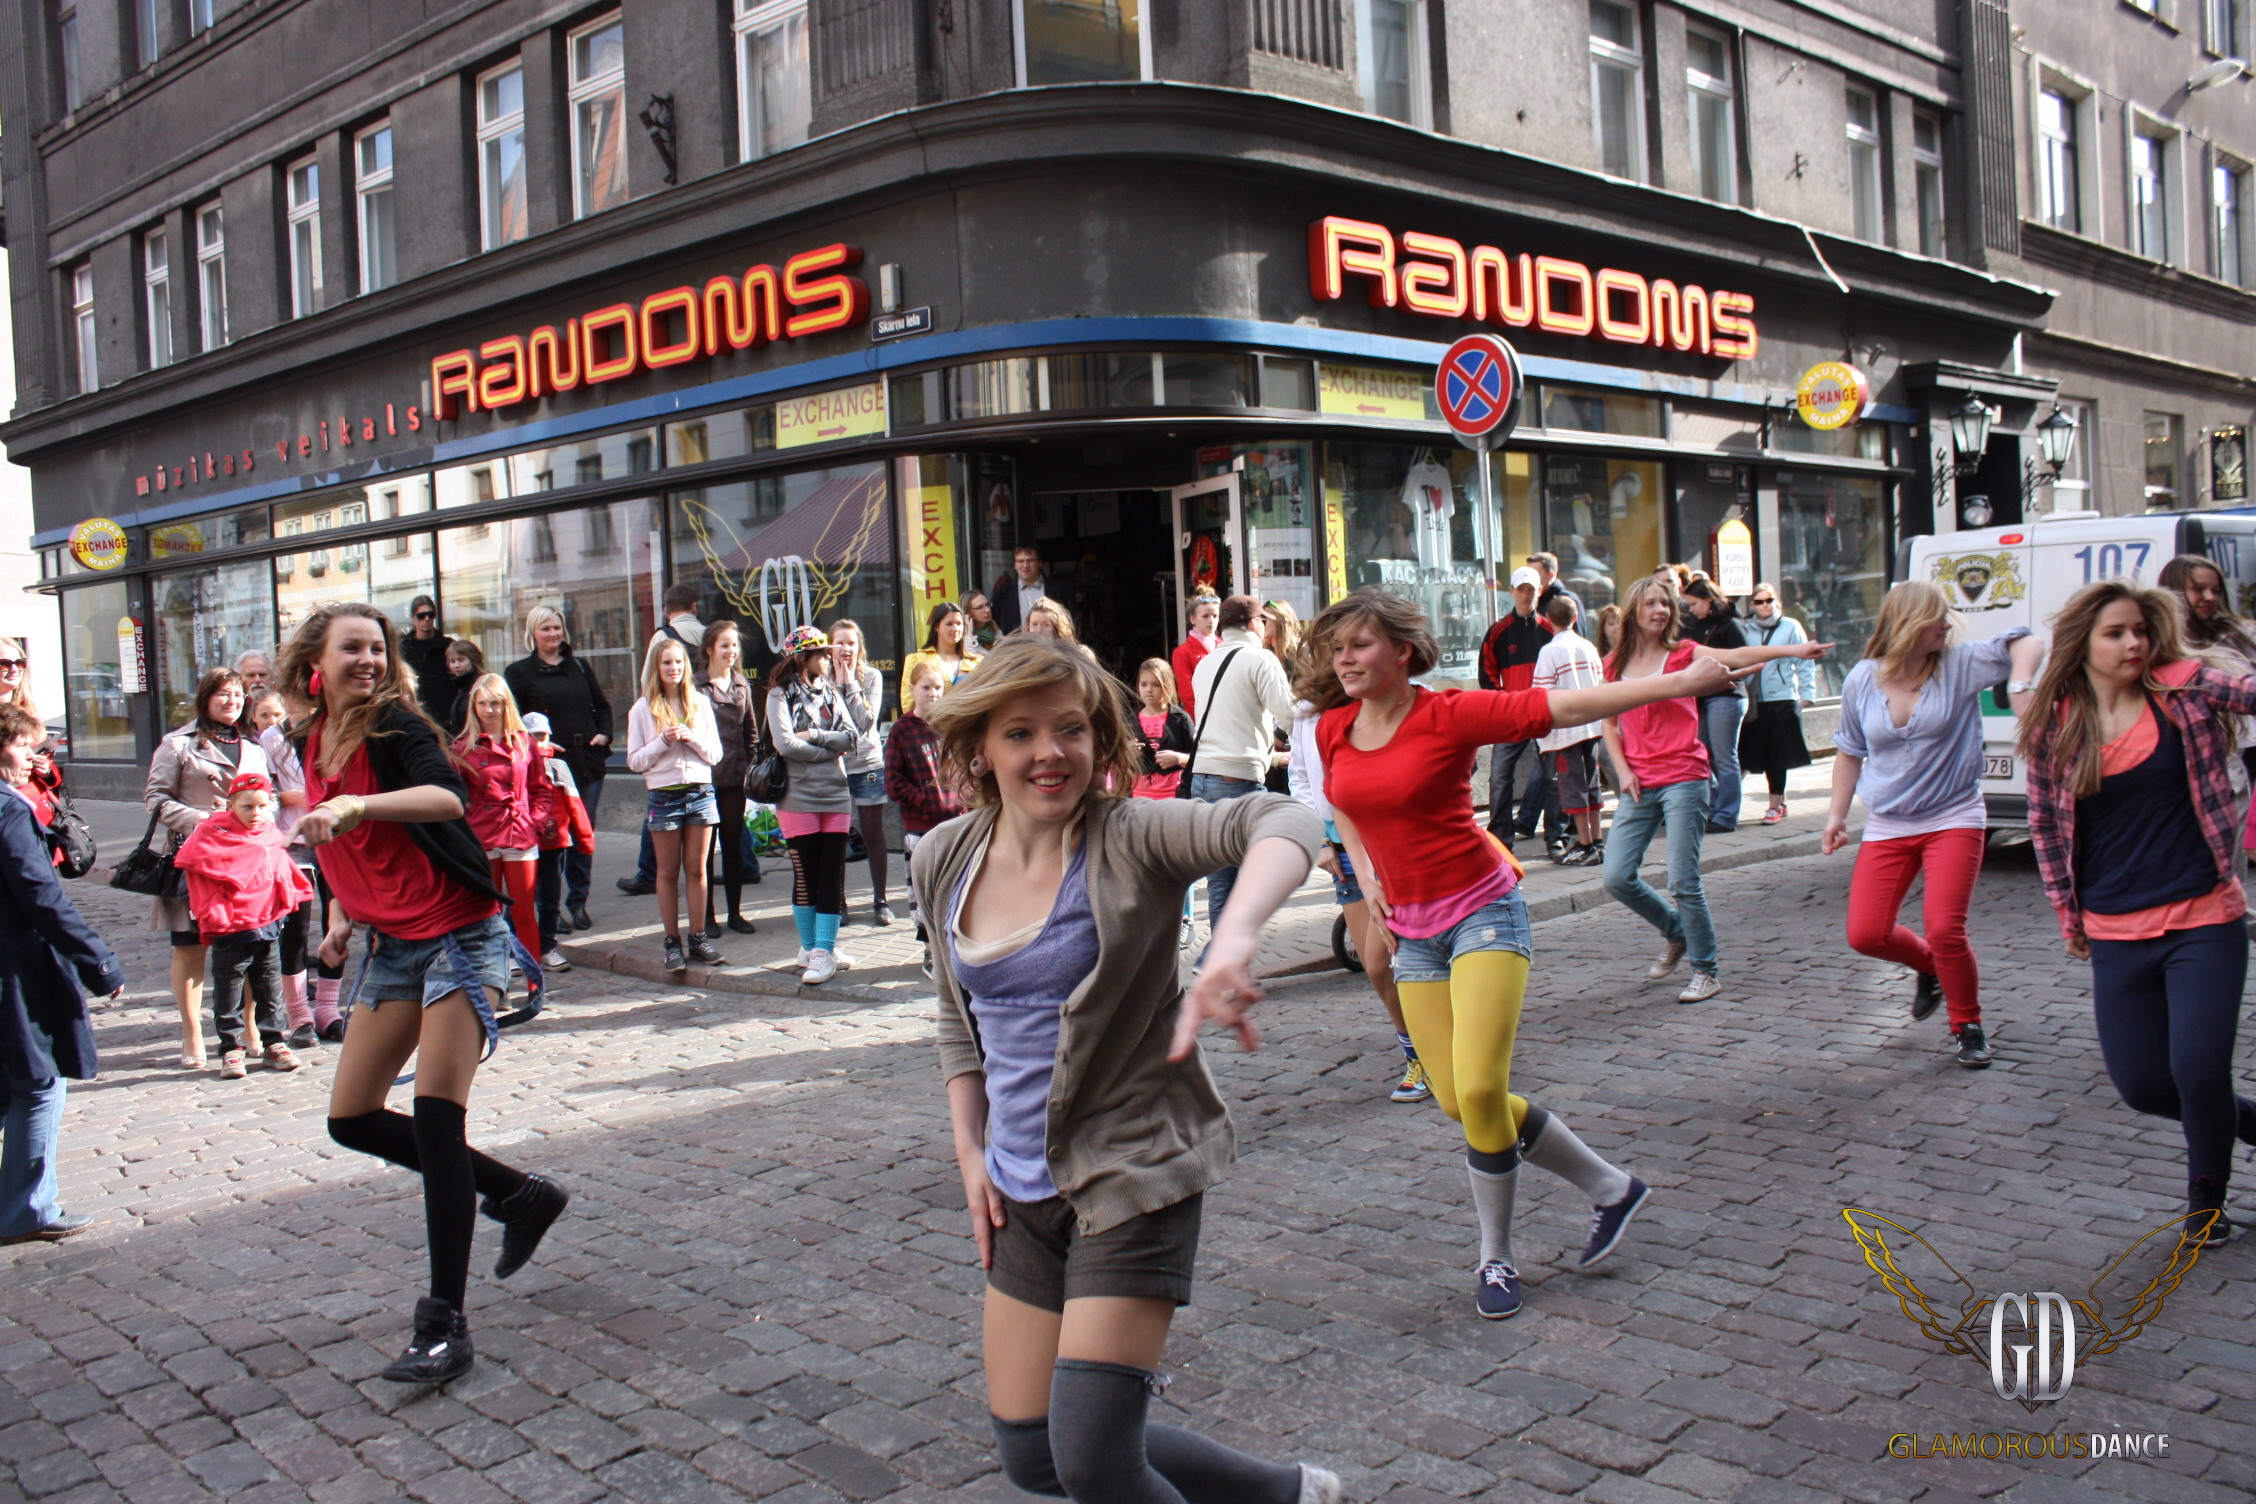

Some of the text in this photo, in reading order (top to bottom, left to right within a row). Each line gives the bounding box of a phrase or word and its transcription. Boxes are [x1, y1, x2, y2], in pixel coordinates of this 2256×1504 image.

[1319, 365, 1420, 401] EXCHANGE
[1797, 387, 1857, 408] EXCHANGE
[779, 384, 884, 429] EXCHANGE
[277, 403, 421, 462] veikals
[76, 537, 128, 554] EXCHANGE
[79, 520, 122, 541] VALŪTAS
[2074, 542, 2151, 585] 107
[134, 626, 148, 692] EXCHANGE
